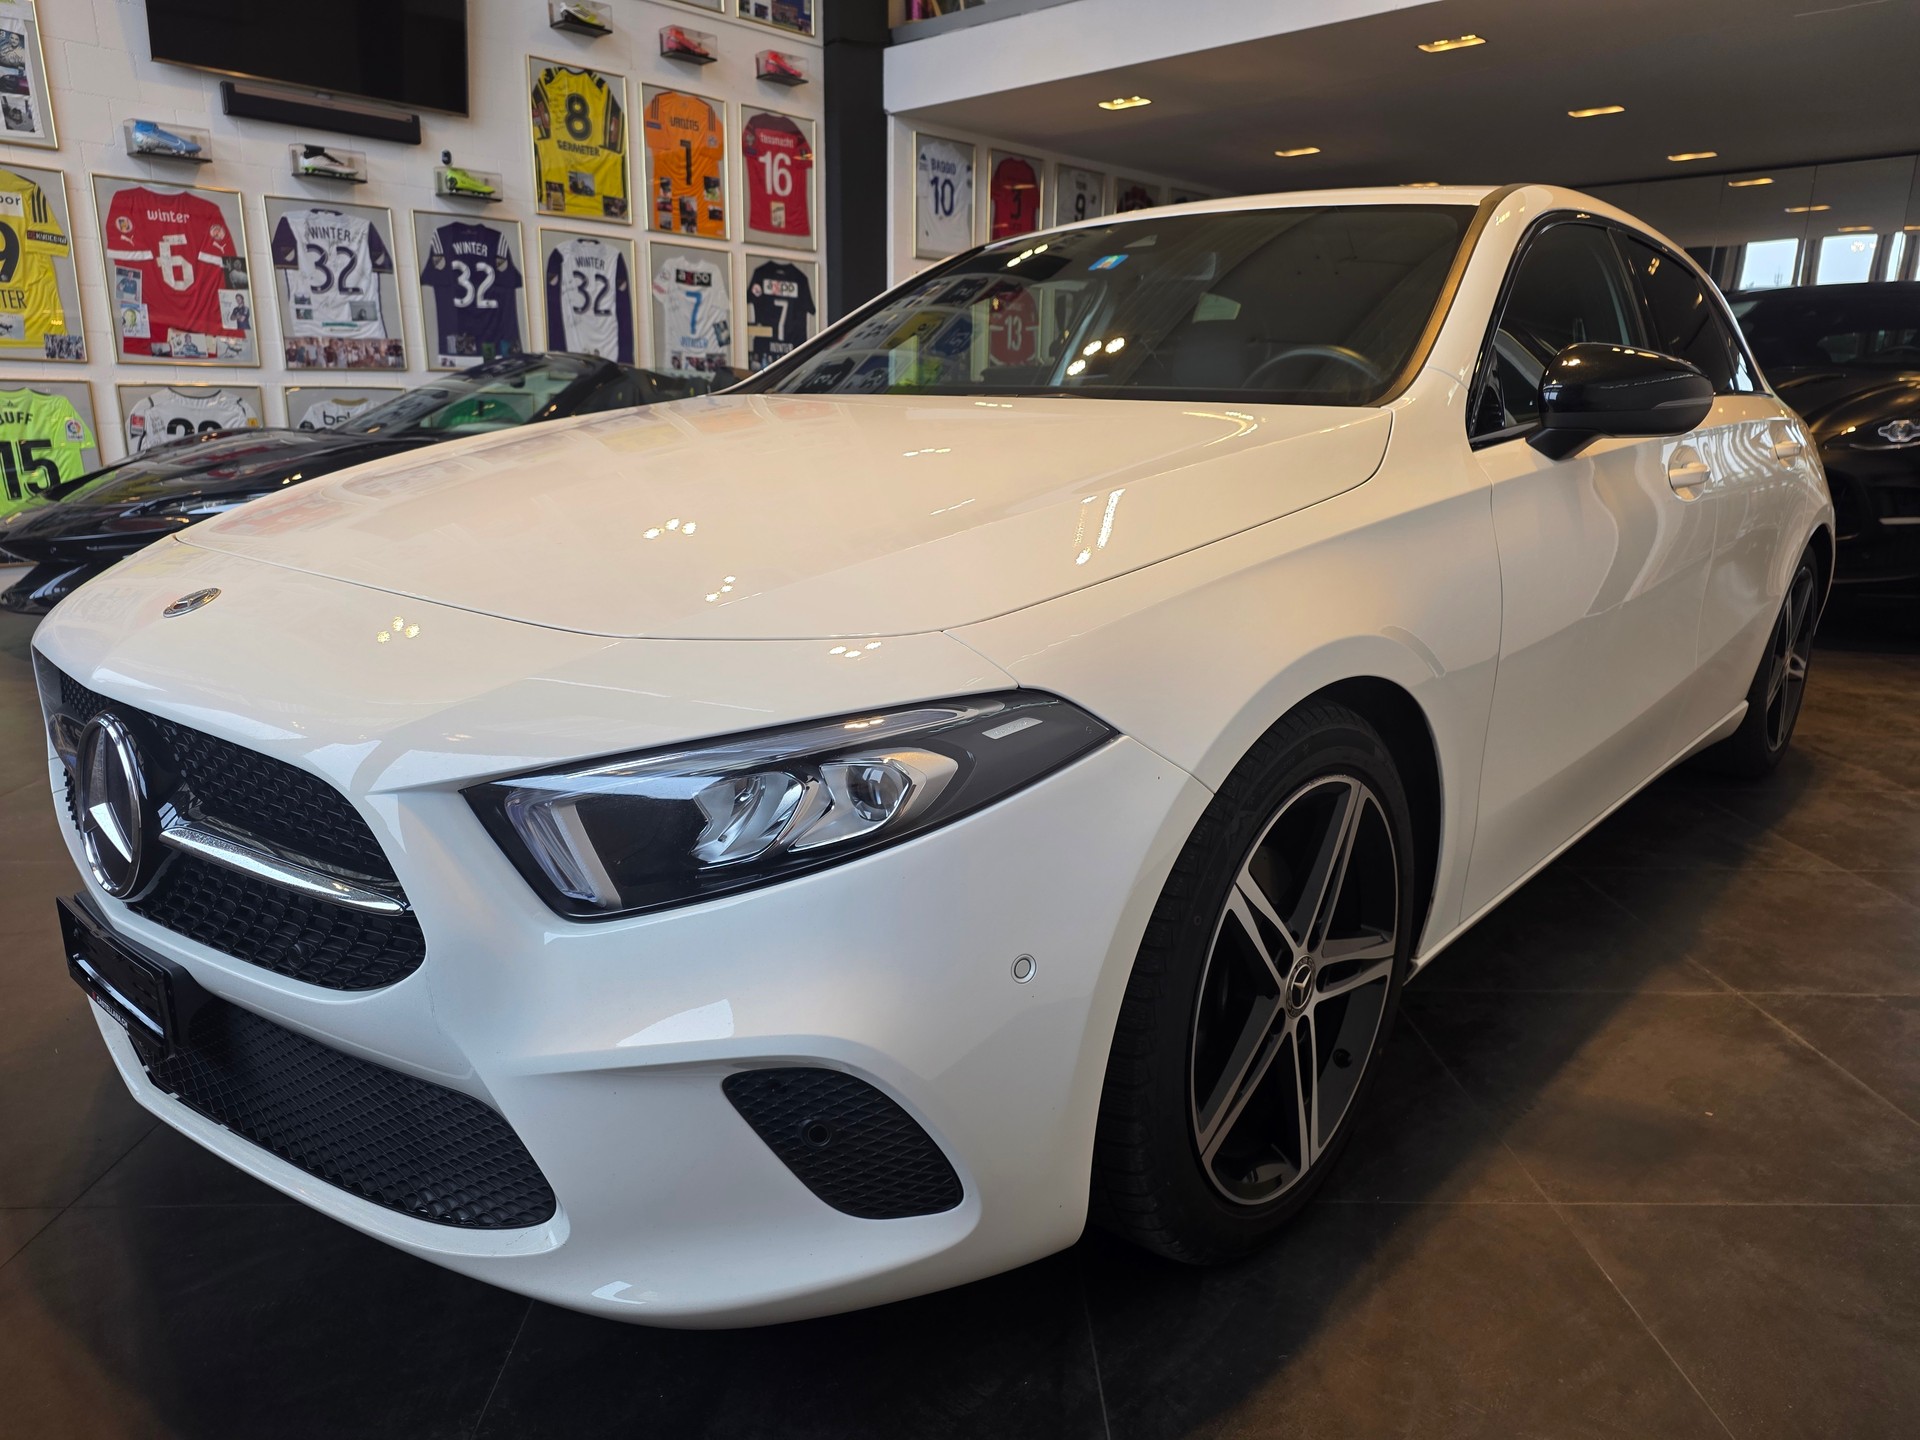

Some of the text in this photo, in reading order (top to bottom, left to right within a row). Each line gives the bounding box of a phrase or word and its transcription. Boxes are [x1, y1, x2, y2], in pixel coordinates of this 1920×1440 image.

[565, 92, 592, 141] 8
[680, 139, 692, 186] 1
[758, 151, 793, 197] 16
[147, 209, 190, 224] winter
[930, 176, 954, 216] 10
[308, 226, 351, 242] WINTER
[453, 241, 488, 257] WINTER
[157, 234, 194, 291] 6
[306, 243, 364, 295] 32
[451, 260, 499, 309] 32
[575, 257, 605, 271] WINTER
[572, 270, 613, 316] 32
[685, 291, 702, 335] 7
[774, 300, 789, 341] 7
[1004, 315, 1022, 351] 13
[0, 439, 61, 500] 15
